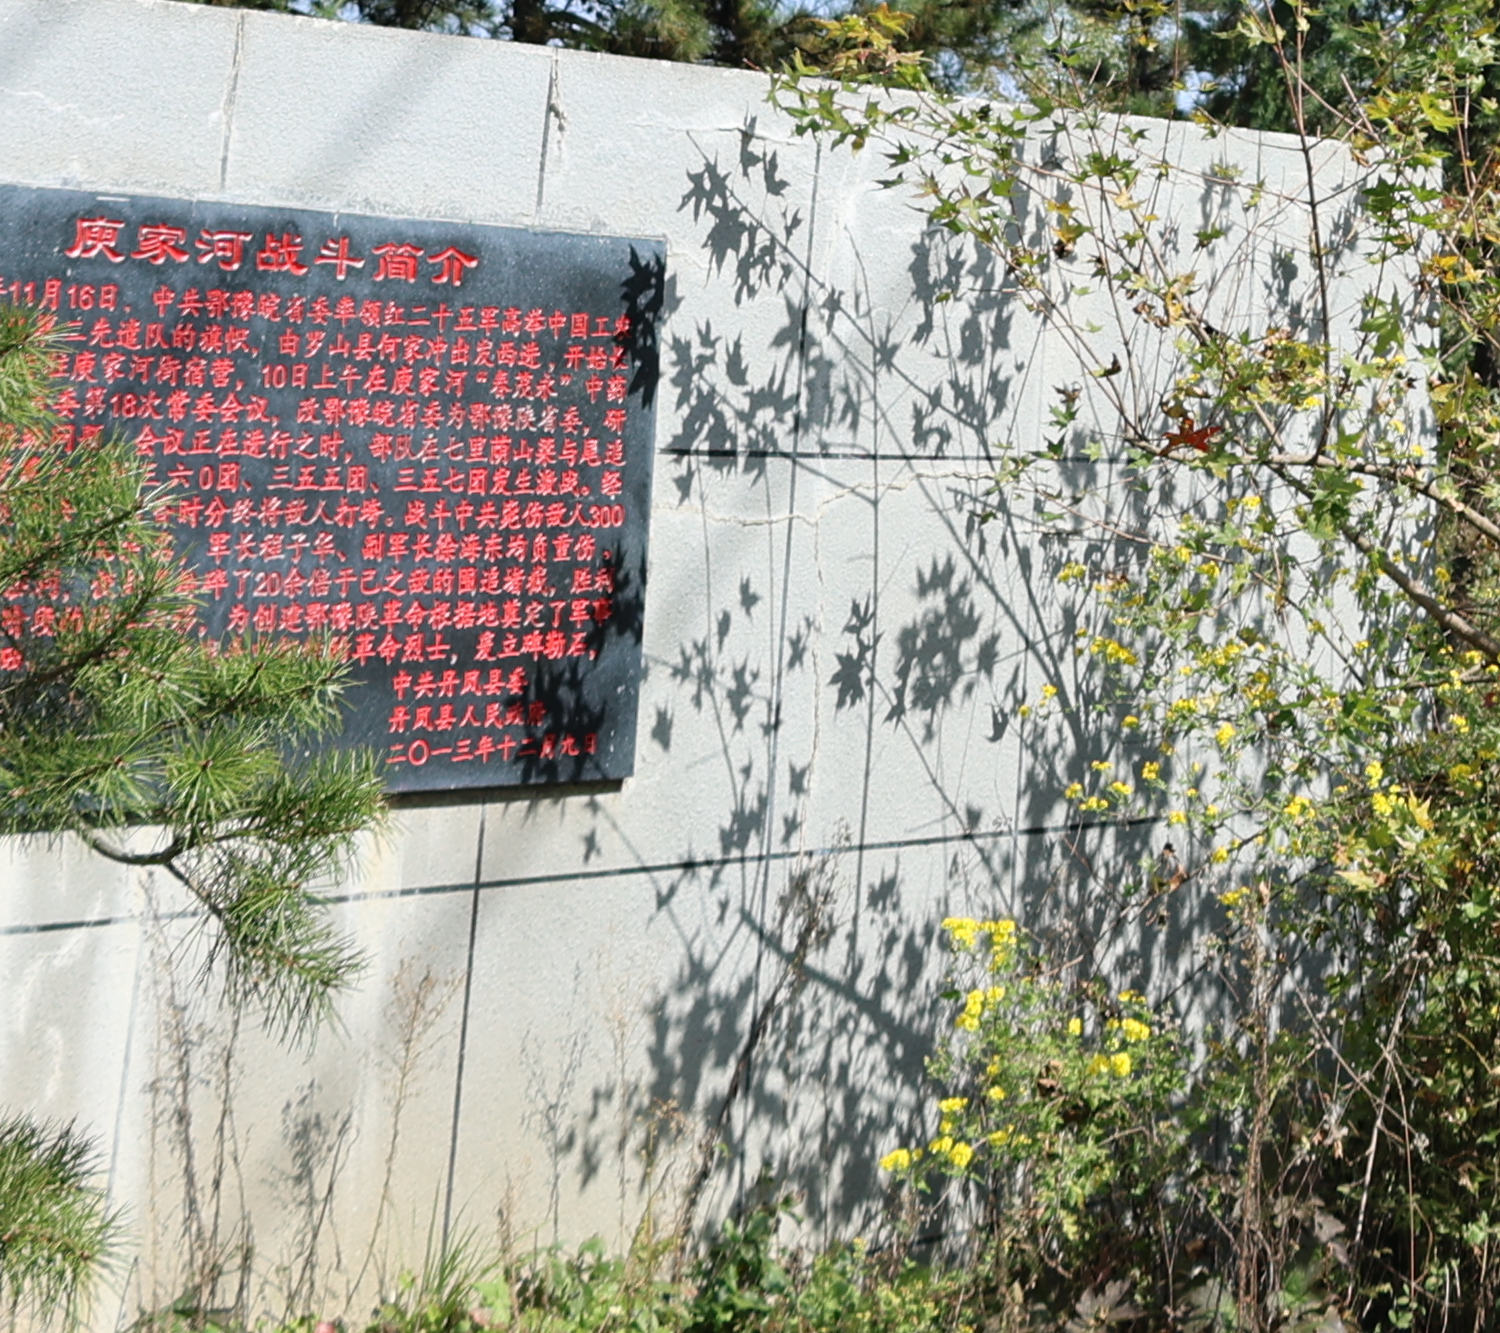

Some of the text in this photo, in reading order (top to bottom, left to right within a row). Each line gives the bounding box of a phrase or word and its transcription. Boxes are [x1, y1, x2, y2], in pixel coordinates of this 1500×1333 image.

[66, 216, 479, 286] 庾家河战斗简介
[389, 666, 530, 699] 中共丹凤县委
